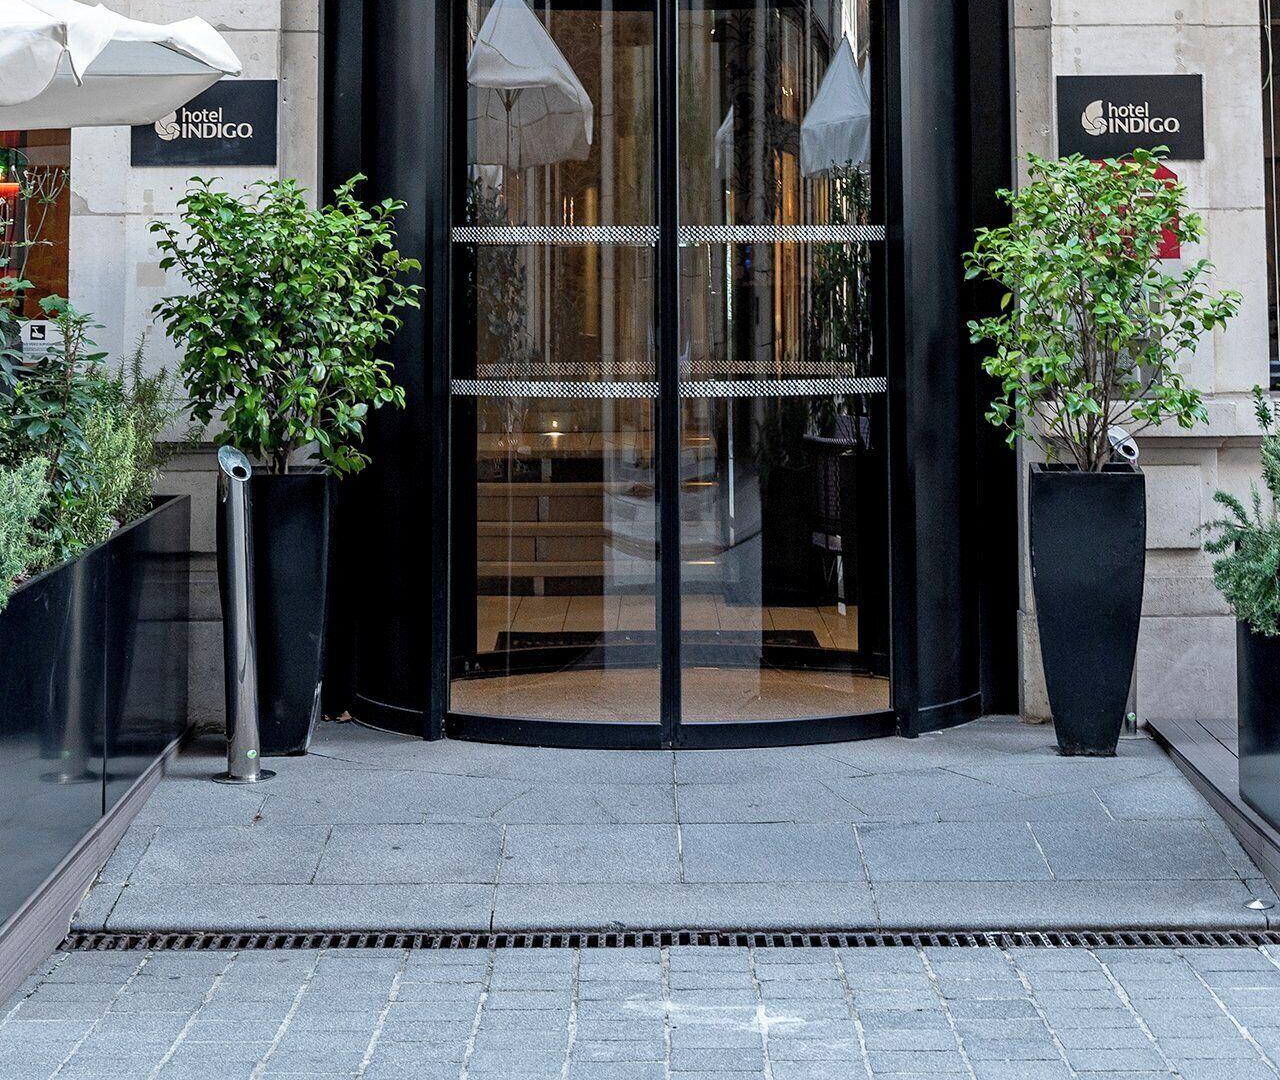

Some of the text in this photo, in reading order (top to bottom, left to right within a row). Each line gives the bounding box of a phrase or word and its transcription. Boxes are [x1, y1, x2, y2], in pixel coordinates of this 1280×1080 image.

[181, 107, 222, 123] hotel
[1108, 101, 1149, 117] hotel
[181, 123, 253, 139] INDIGO
[1108, 117, 1180, 133] INDIGO
